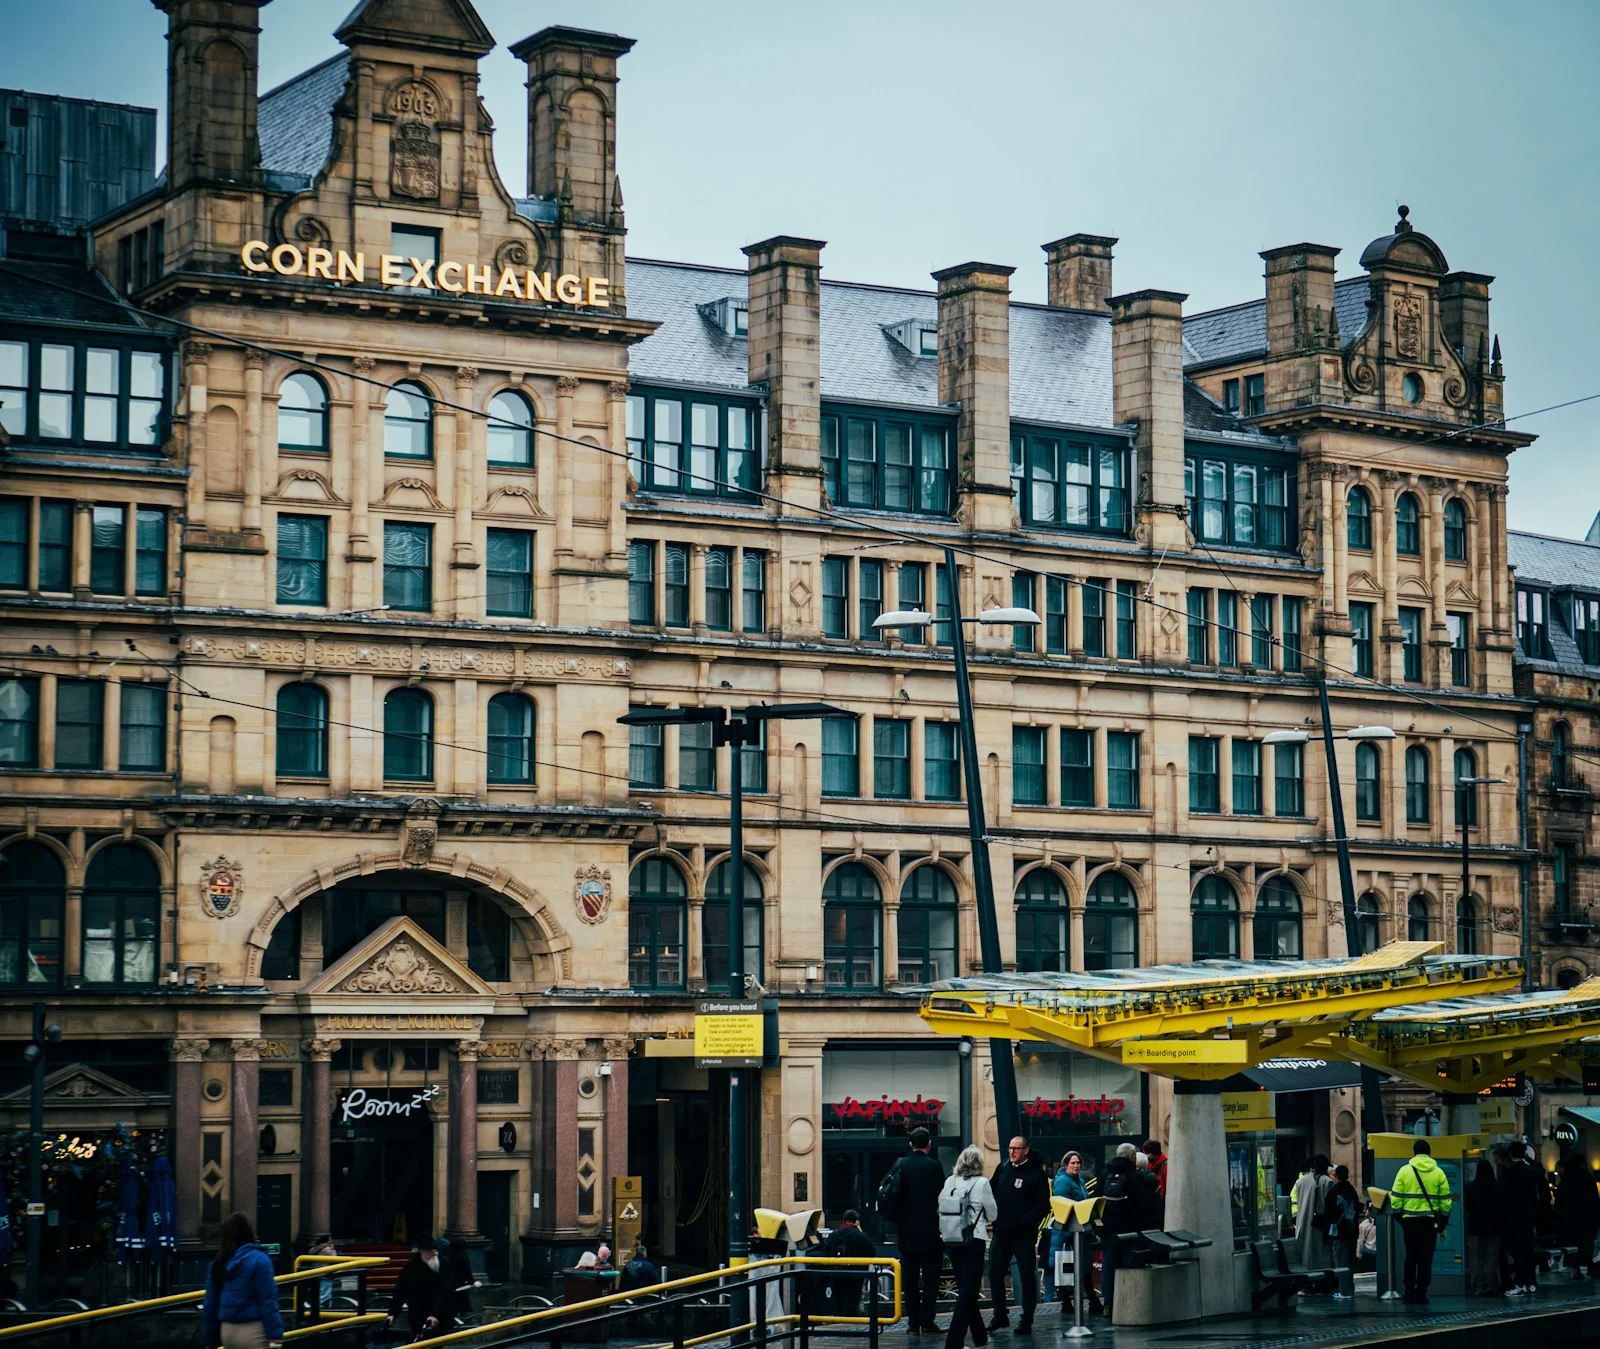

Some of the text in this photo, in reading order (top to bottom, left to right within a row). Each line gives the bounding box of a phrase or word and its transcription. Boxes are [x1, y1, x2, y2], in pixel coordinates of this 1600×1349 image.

[395, 93, 435, 115] 1903
[241, 240, 610, 307] CORN EXCHANGE
[709, 1003, 757, 1012] Before you board
[327, 1014, 472, 1029] PRODUCE EXCHANGE
[1146, 1048, 1196, 1059] Boarding point
